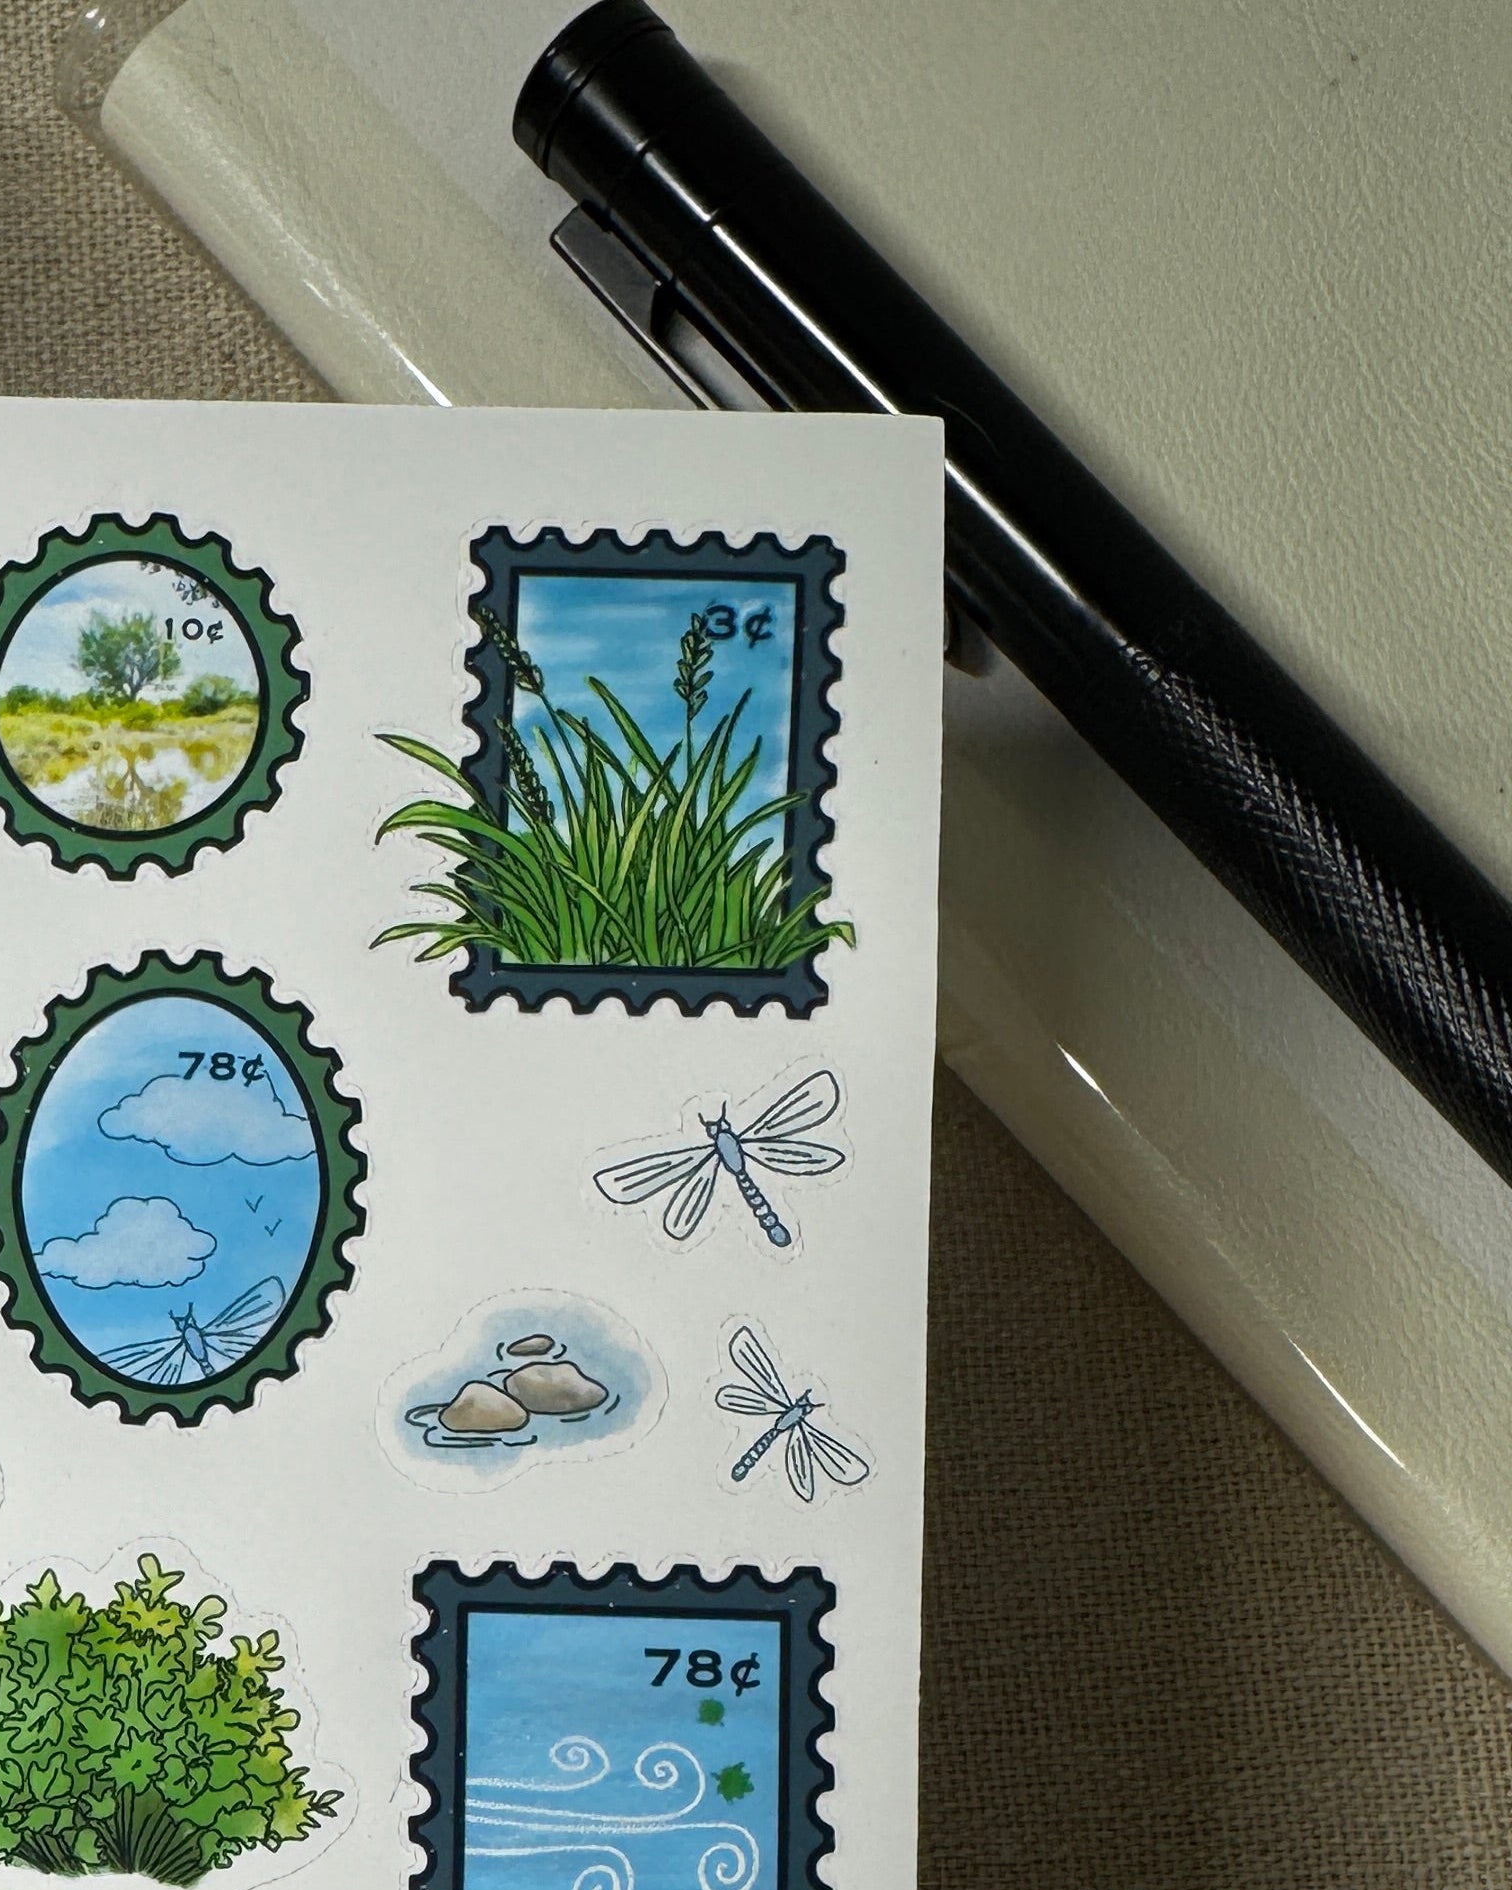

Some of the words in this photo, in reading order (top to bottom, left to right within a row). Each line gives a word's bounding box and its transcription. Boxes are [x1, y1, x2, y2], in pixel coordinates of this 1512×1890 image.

[165, 617, 224, 644] 10¢
[706, 604, 774, 649] 3¢
[178, 1051, 265, 1088] 78¢
[644, 1648, 761, 1697] 78¢
